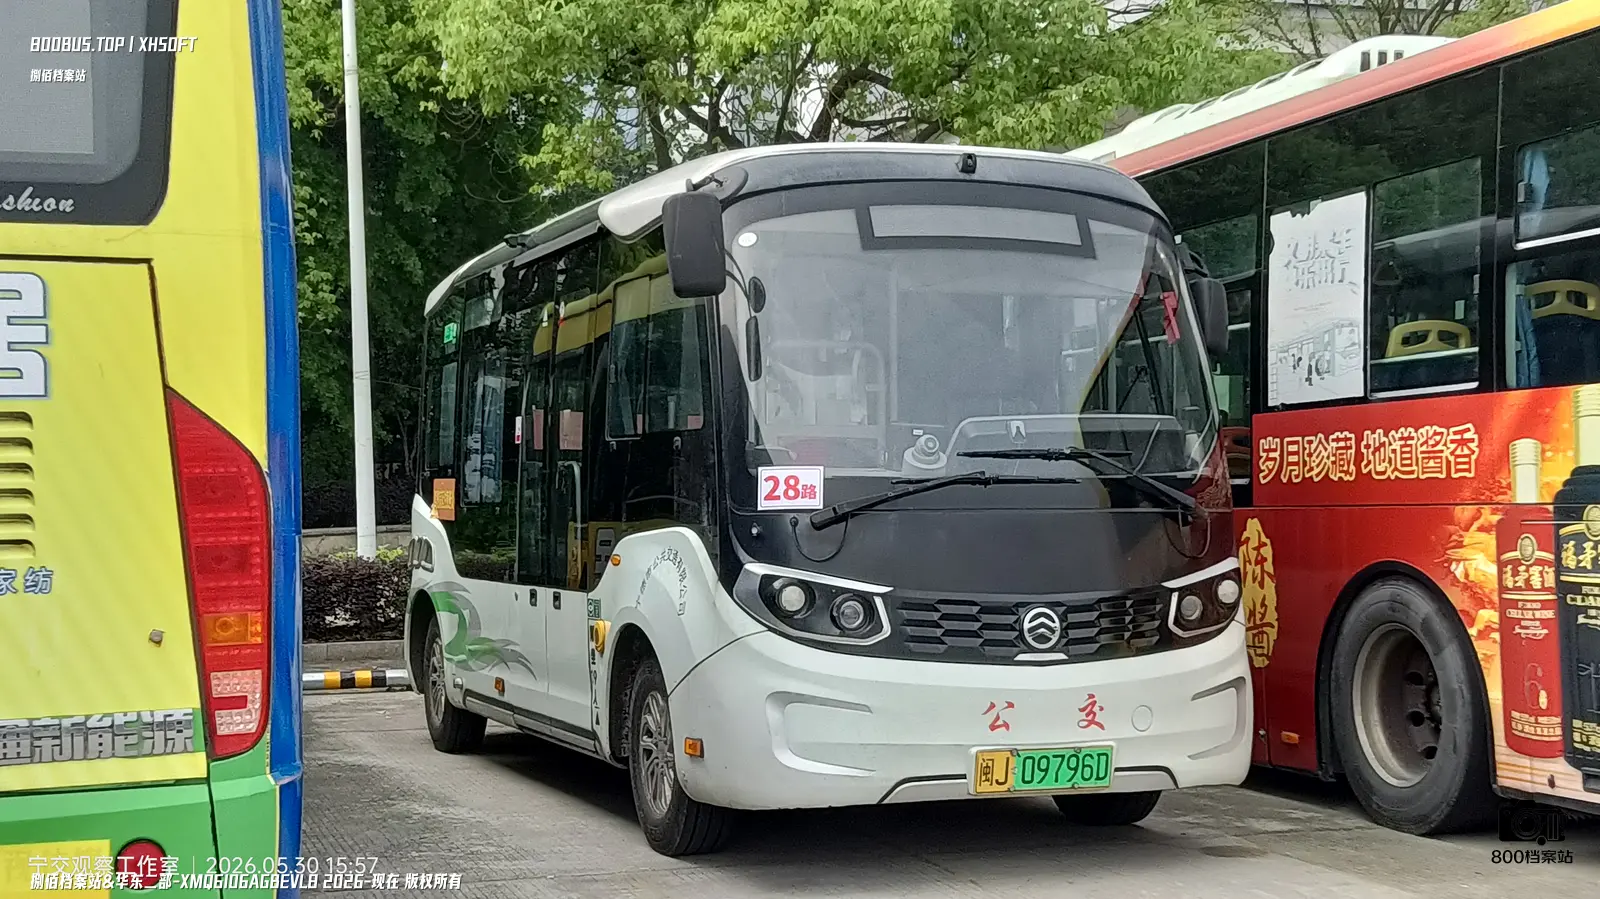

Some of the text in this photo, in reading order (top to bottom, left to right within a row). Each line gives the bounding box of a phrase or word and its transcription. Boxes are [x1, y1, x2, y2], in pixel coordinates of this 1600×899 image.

[0, 186, 75, 213] shion
[1259, 423, 1479, 484] 岁月珍藏 地道酱香
[763, 475, 818, 501] 28路
[981, 693, 1106, 732] 公交
[0, 708, 194, 767] 通新能源
